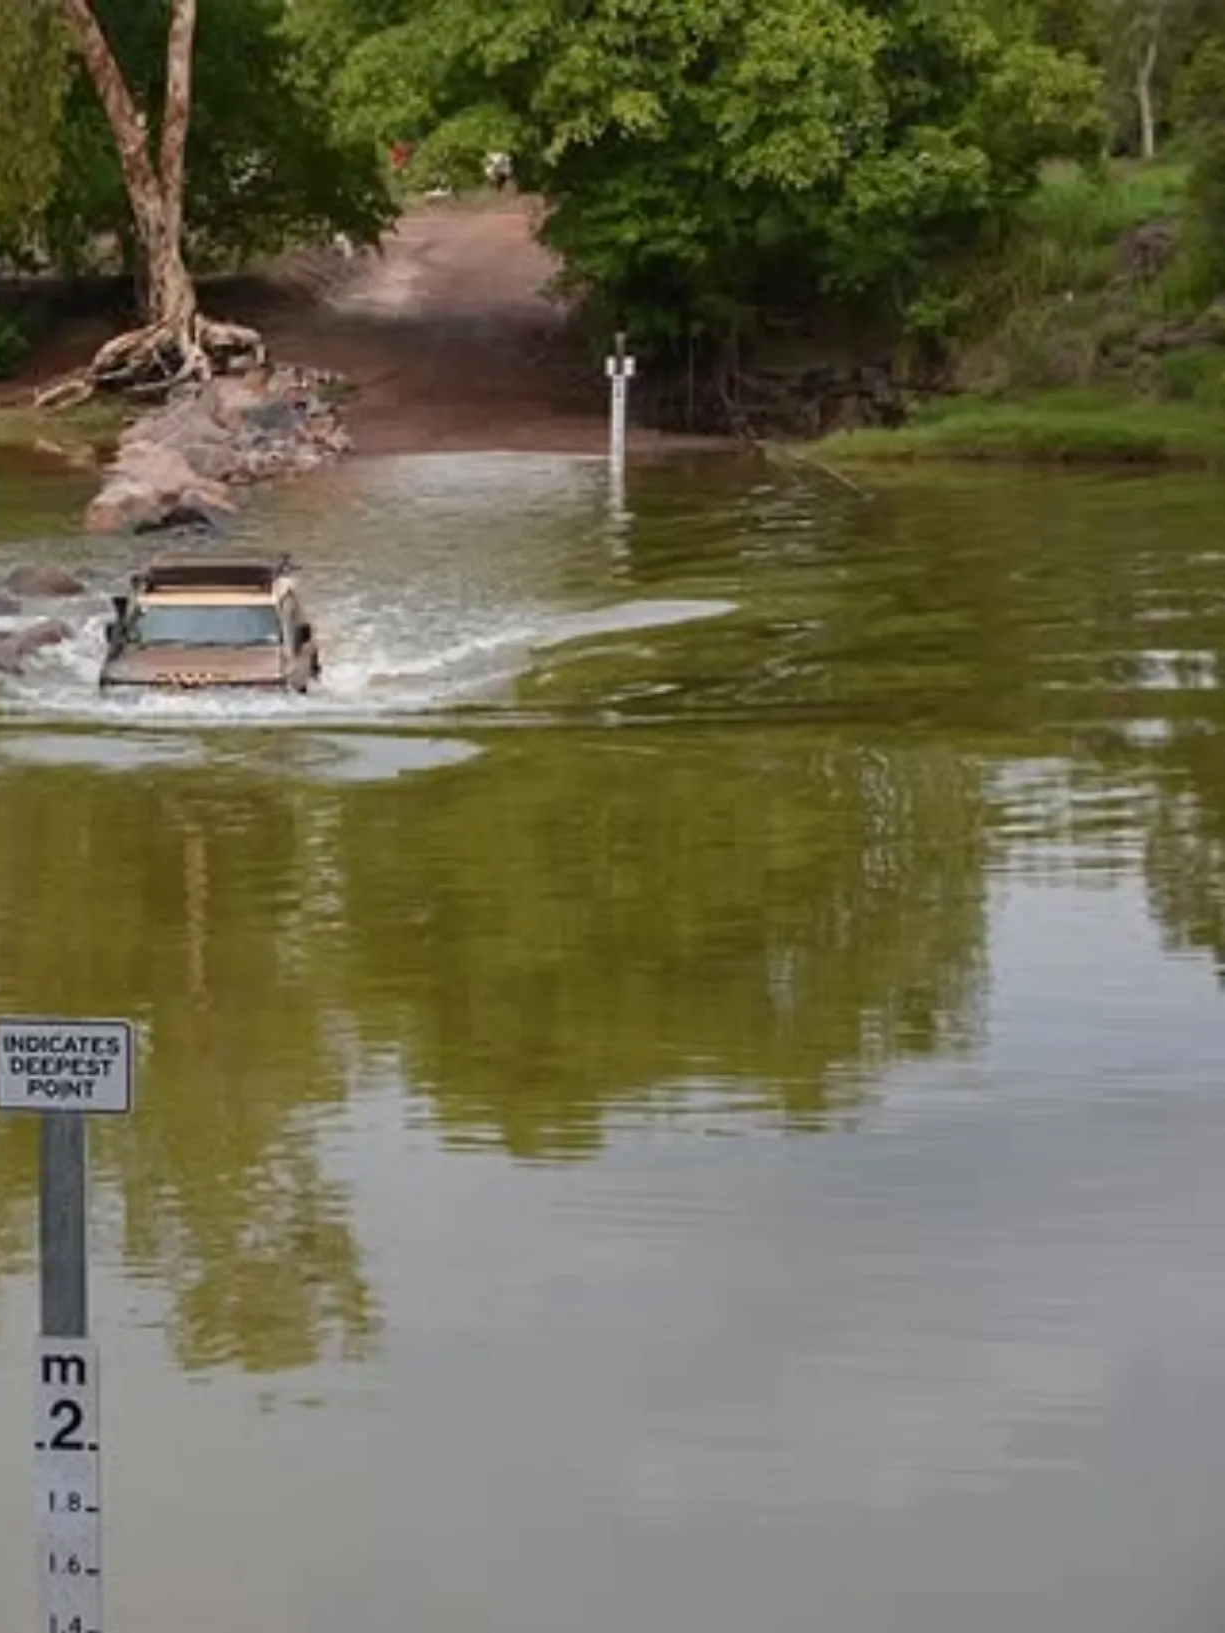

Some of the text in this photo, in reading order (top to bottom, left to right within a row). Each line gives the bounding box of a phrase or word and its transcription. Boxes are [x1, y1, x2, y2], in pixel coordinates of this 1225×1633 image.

[3, 1035, 120, 1054] INDICATES
[10, 1056, 114, 1076] DEEPEST
[26, 1079, 96, 1099] POINT
[41, 1354, 86, 1386] m
